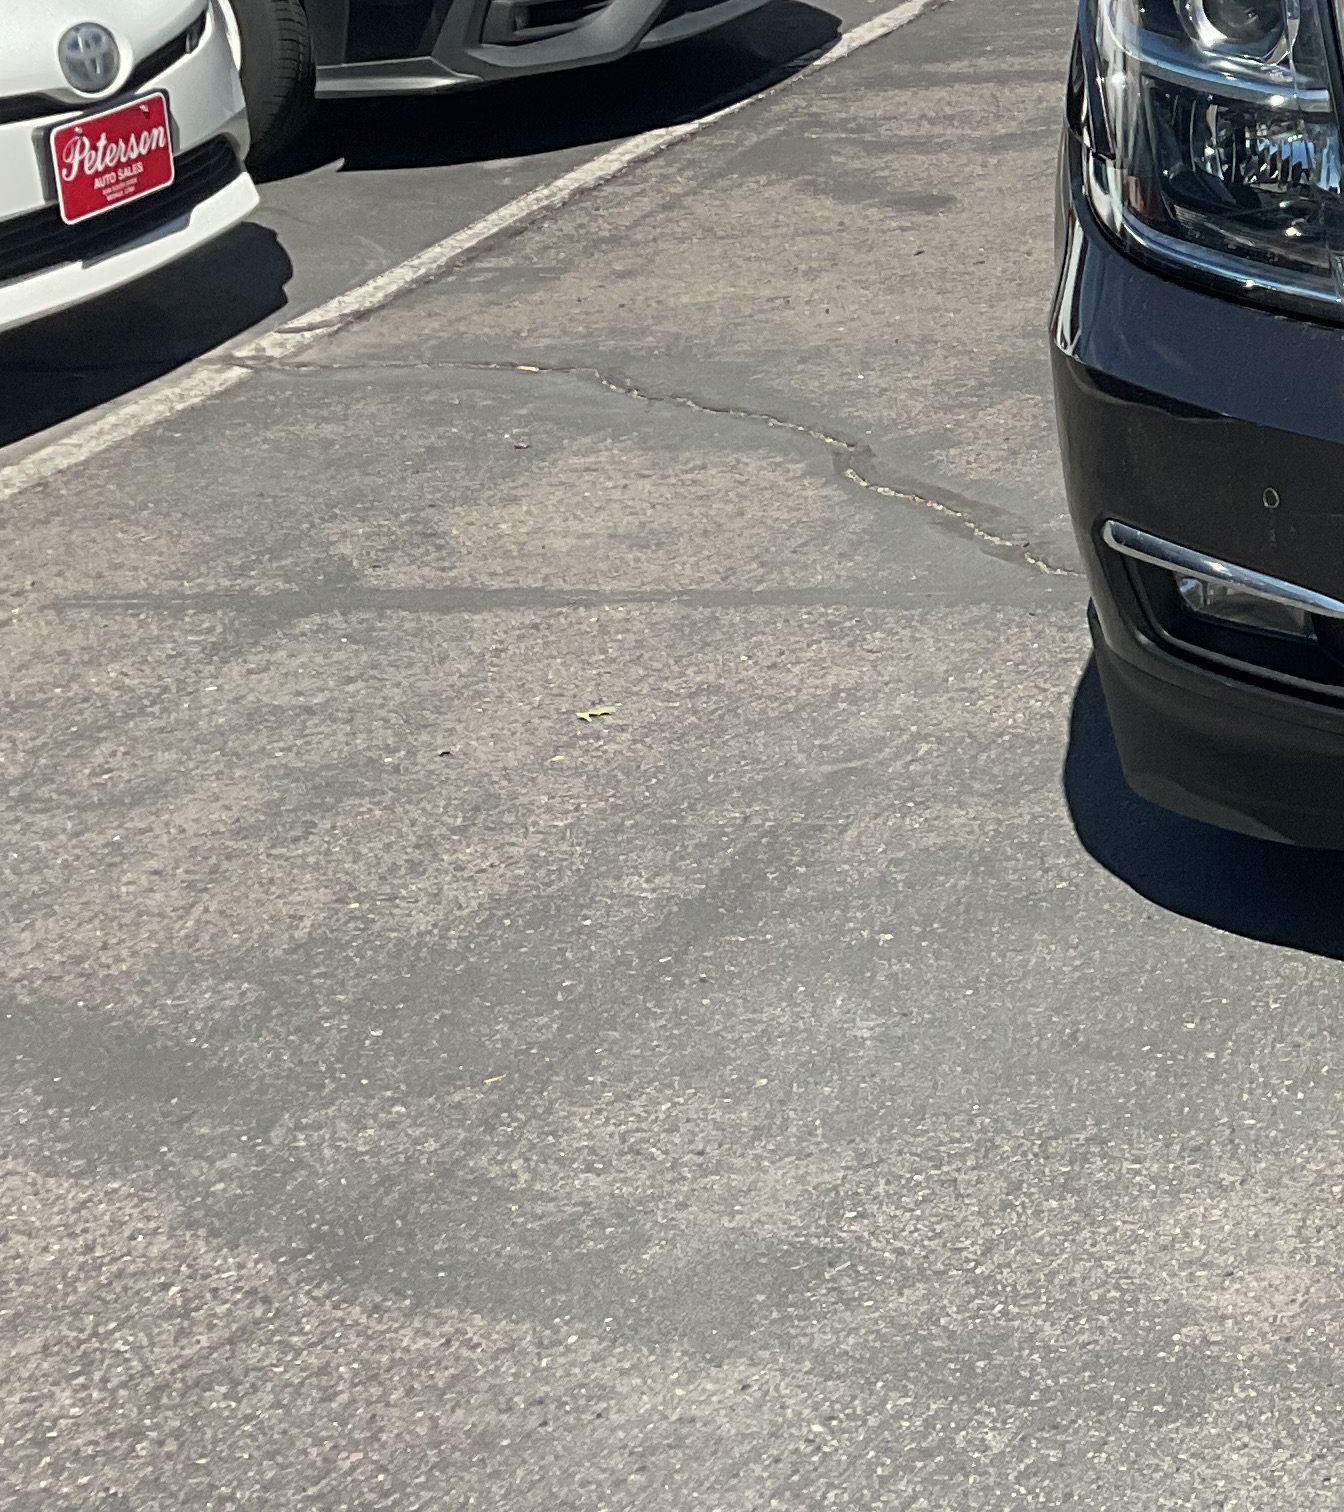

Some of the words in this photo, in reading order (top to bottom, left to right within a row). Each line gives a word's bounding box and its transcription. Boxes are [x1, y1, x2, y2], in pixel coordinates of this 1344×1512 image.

[62, 126, 166, 182] Peterson
[94, 172, 116, 189] AUTO
[118, 162, 144, 180] SALES
